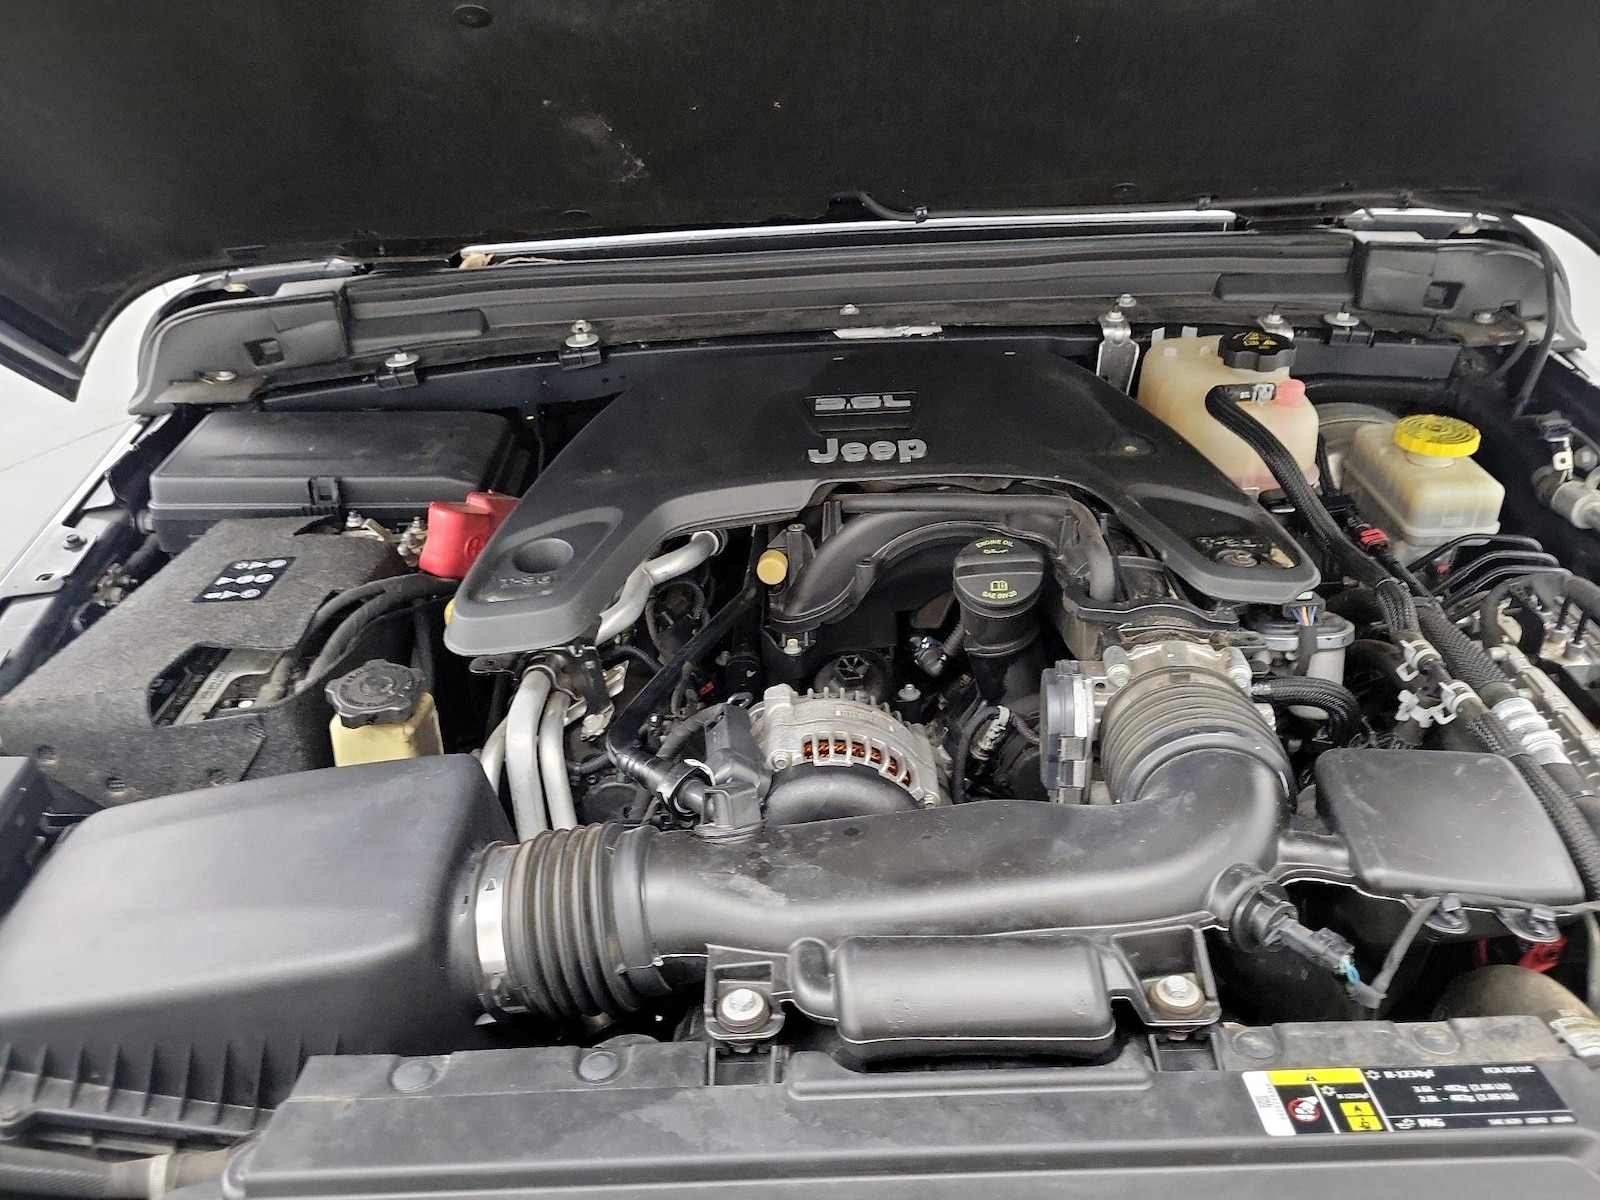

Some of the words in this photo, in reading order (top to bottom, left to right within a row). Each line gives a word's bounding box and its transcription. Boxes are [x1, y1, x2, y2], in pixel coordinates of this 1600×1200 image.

[808, 438, 928, 464] Jeep
[975, 539, 1002, 549] ENGINE
[1002, 539, 1014, 548] OIL
[981, 590, 997, 599] SAE
